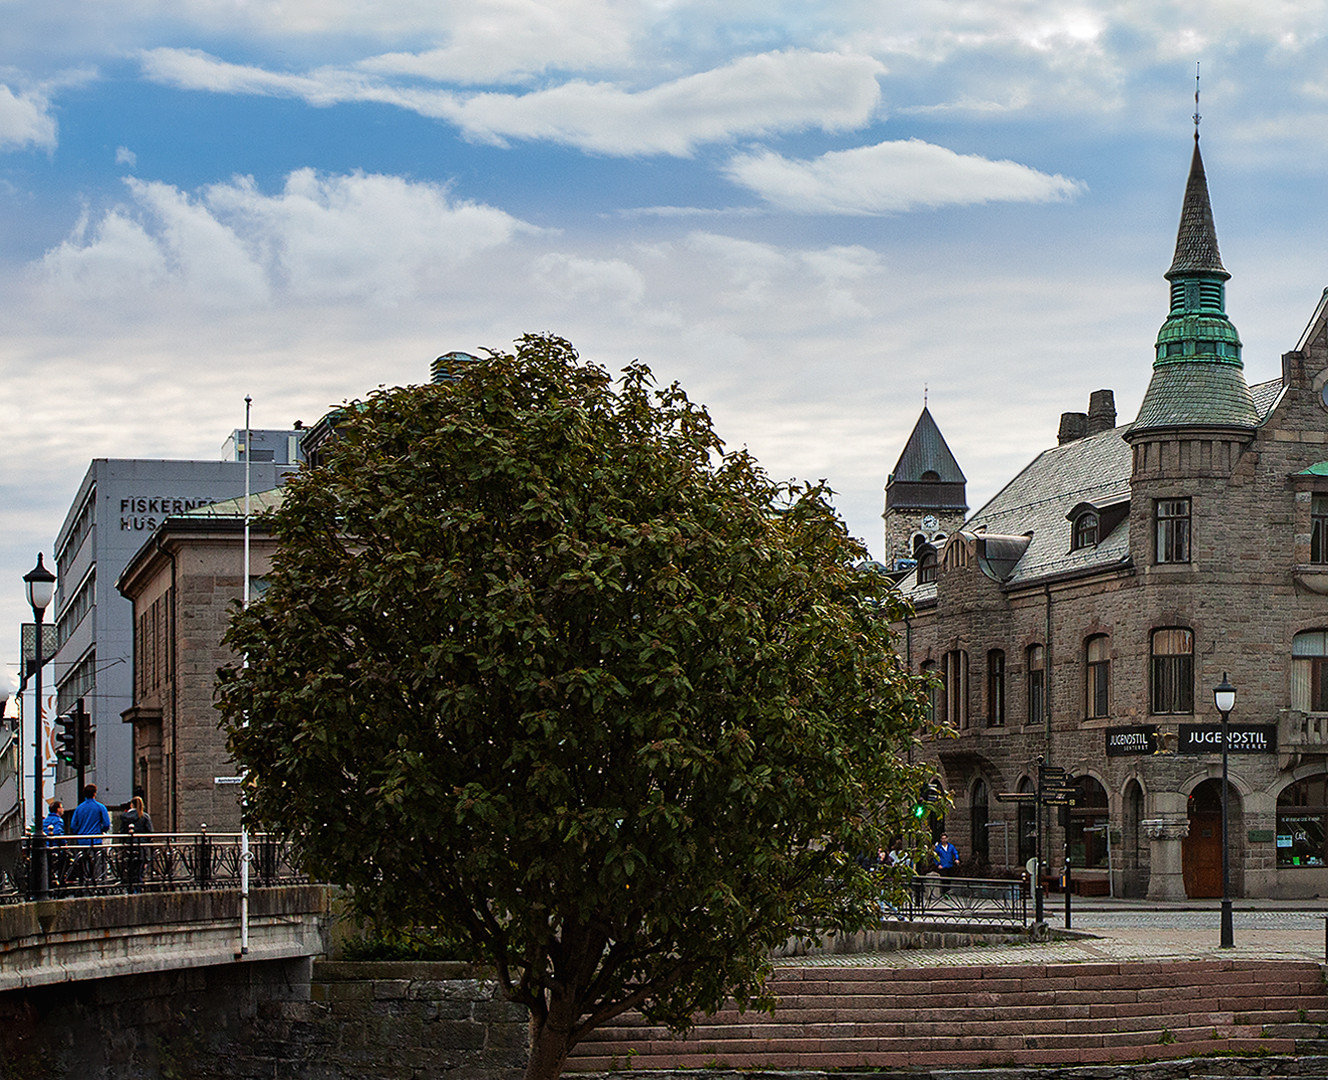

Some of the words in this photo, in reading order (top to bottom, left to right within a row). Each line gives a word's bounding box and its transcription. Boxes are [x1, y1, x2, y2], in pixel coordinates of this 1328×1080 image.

[120, 517, 157, 531] HUS
[1110, 733, 1148, 746] JUGENDSTIL
[1189, 732, 1267, 743] JUGENDSTIL
